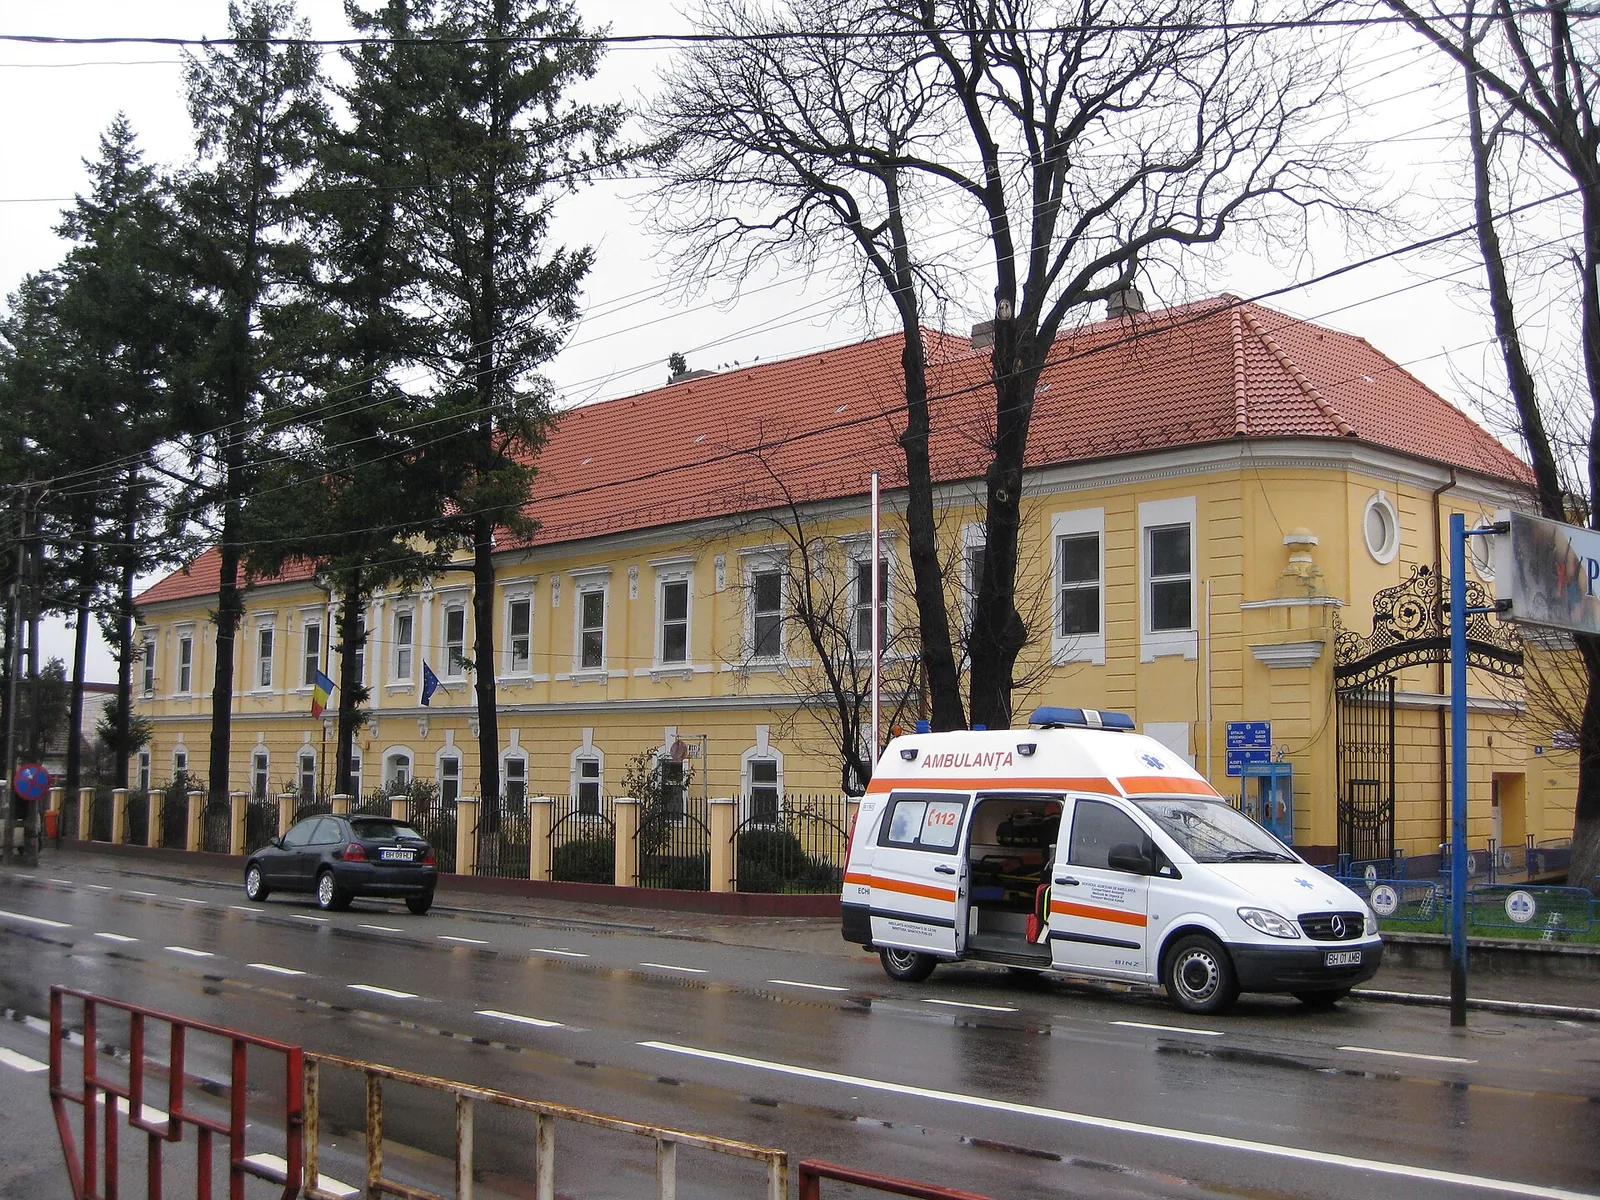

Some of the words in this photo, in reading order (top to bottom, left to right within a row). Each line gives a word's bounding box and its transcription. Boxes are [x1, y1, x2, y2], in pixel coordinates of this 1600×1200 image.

[1586, 557, 1600, 597] P
[934, 811, 956, 826] 112
[1114, 959, 1139, 967] BINZ
[1328, 954, 1338, 964] BH
[1339, 953, 1347, 964] 01
[1348, 952, 1360, 963] AMB
